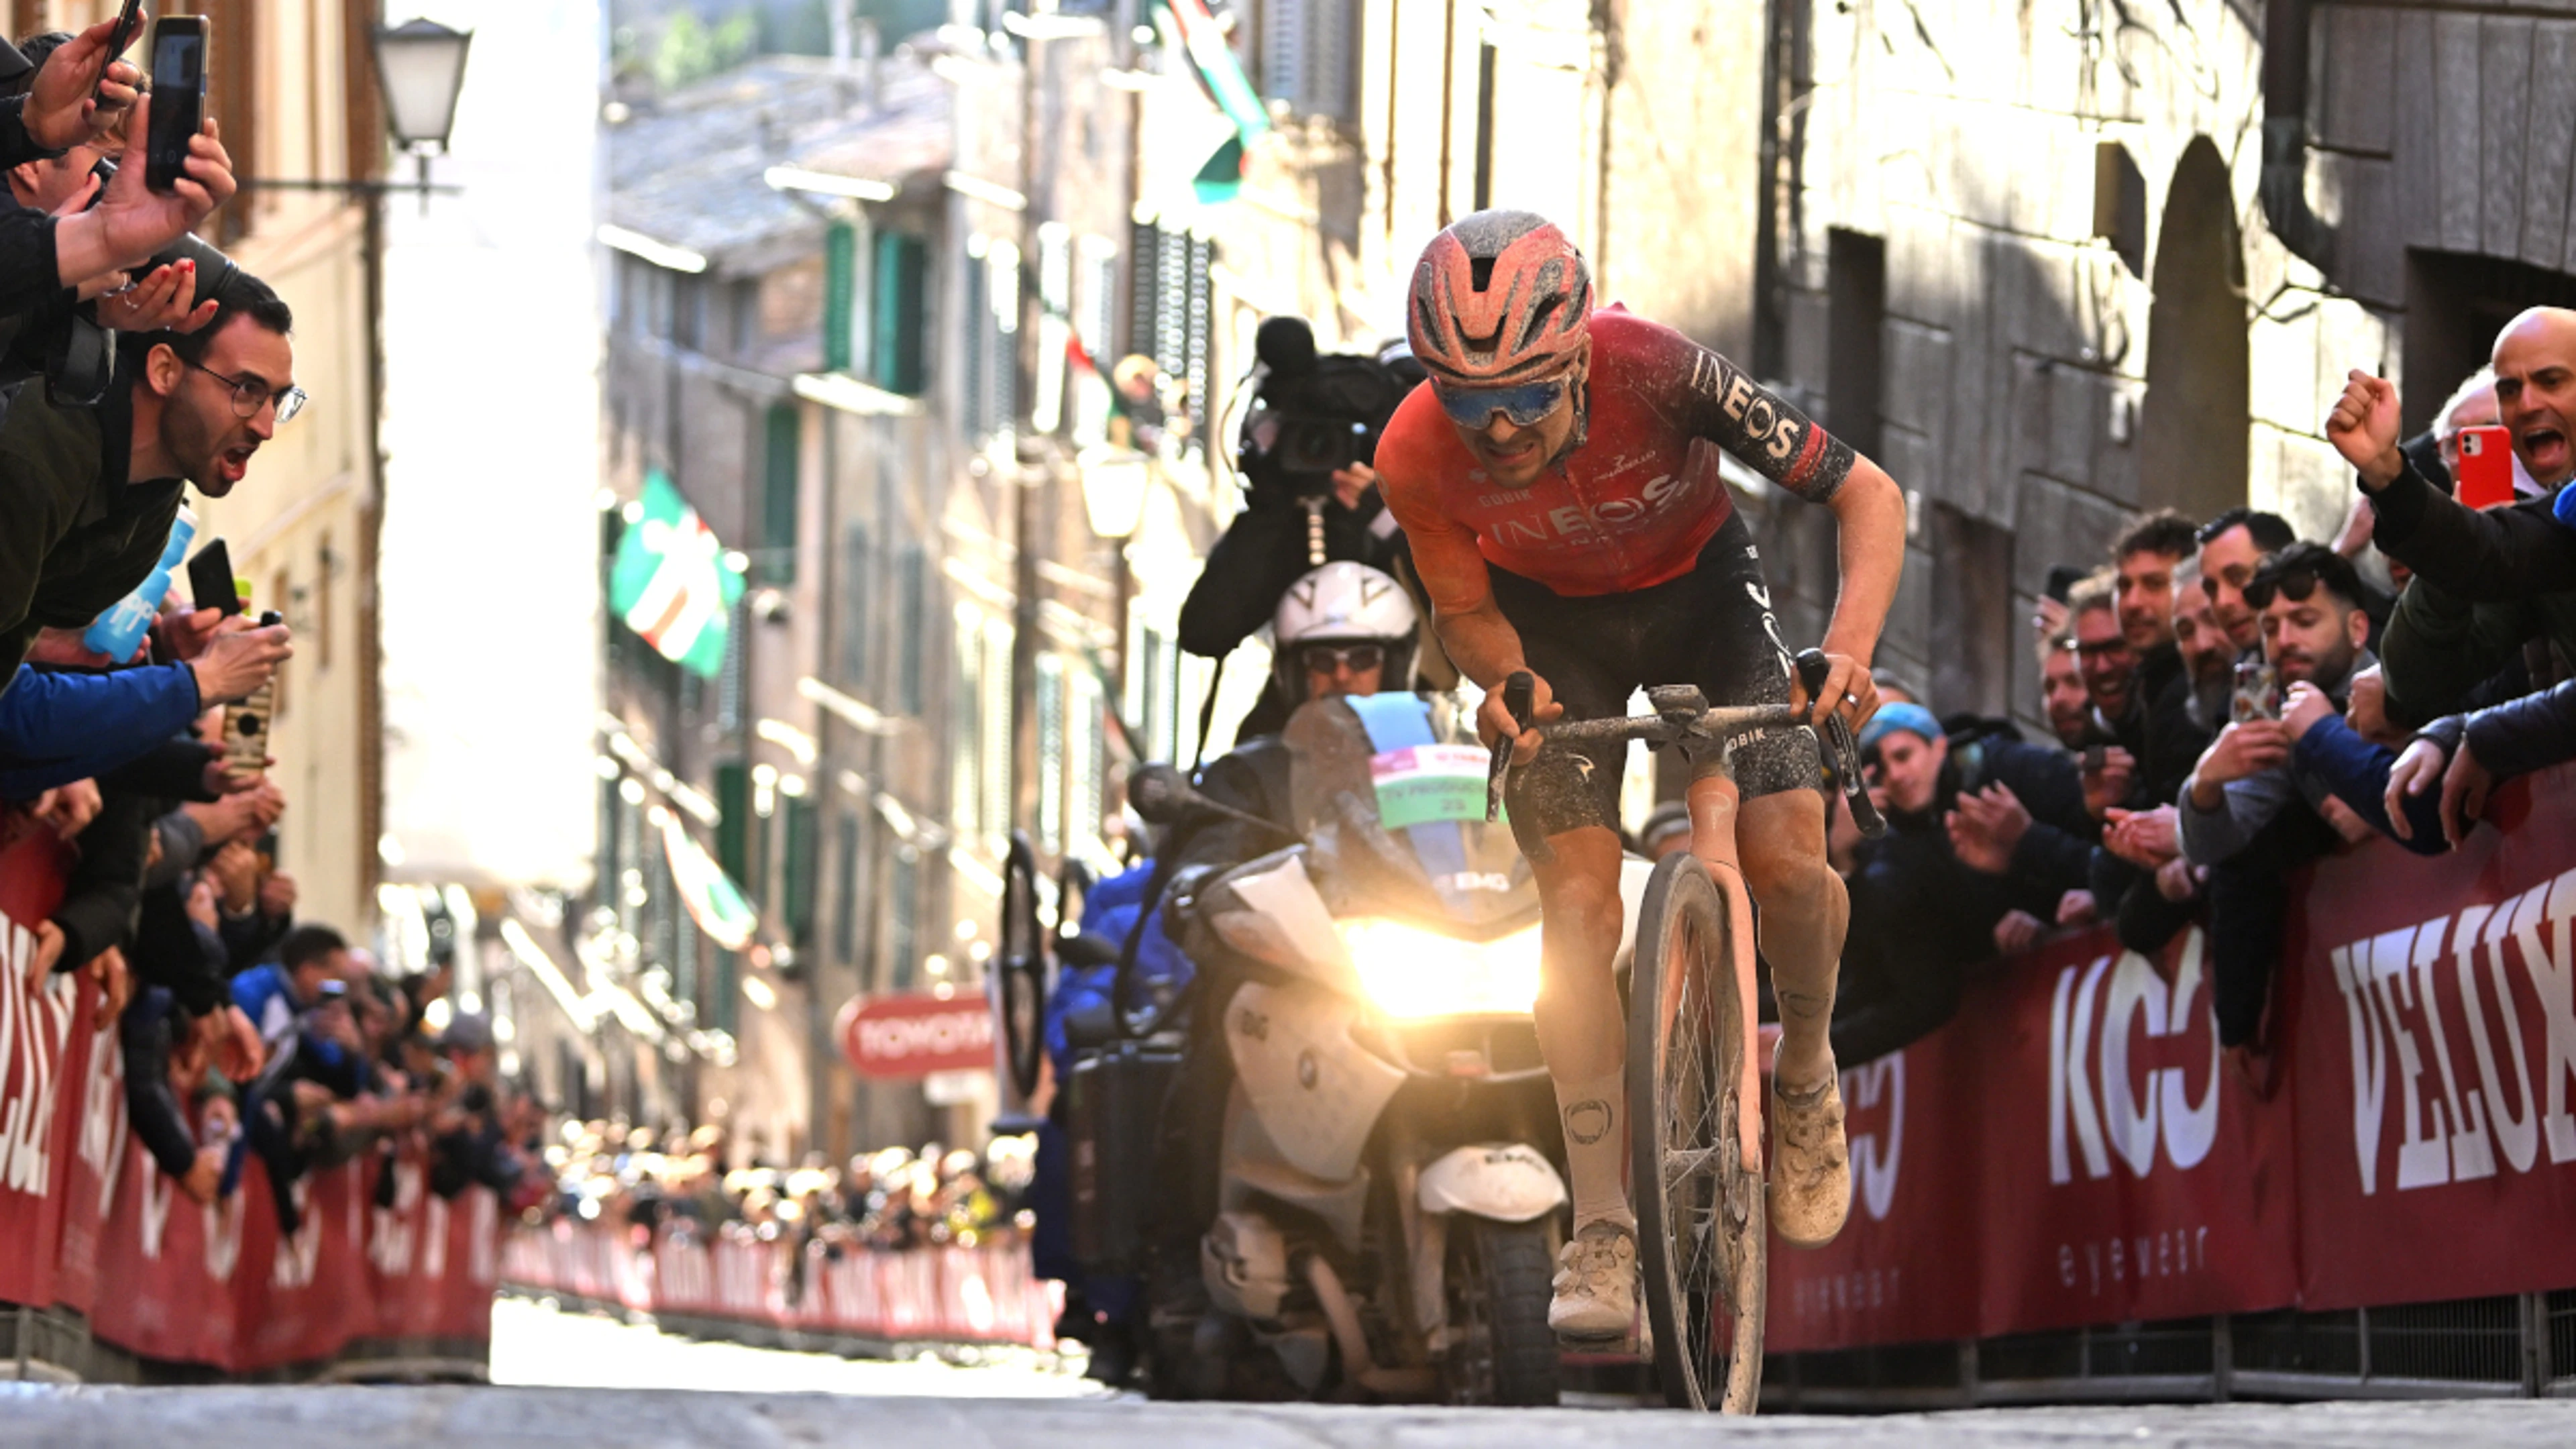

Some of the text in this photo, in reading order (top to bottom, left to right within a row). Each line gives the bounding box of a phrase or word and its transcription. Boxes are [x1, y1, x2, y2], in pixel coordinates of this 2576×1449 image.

[1690, 349, 1801, 459] INEOS
[1491, 474, 1680, 546] INEOS
[1725, 727, 1767, 752] OBIK
[2057, 1225, 2208, 1297] eyewear
